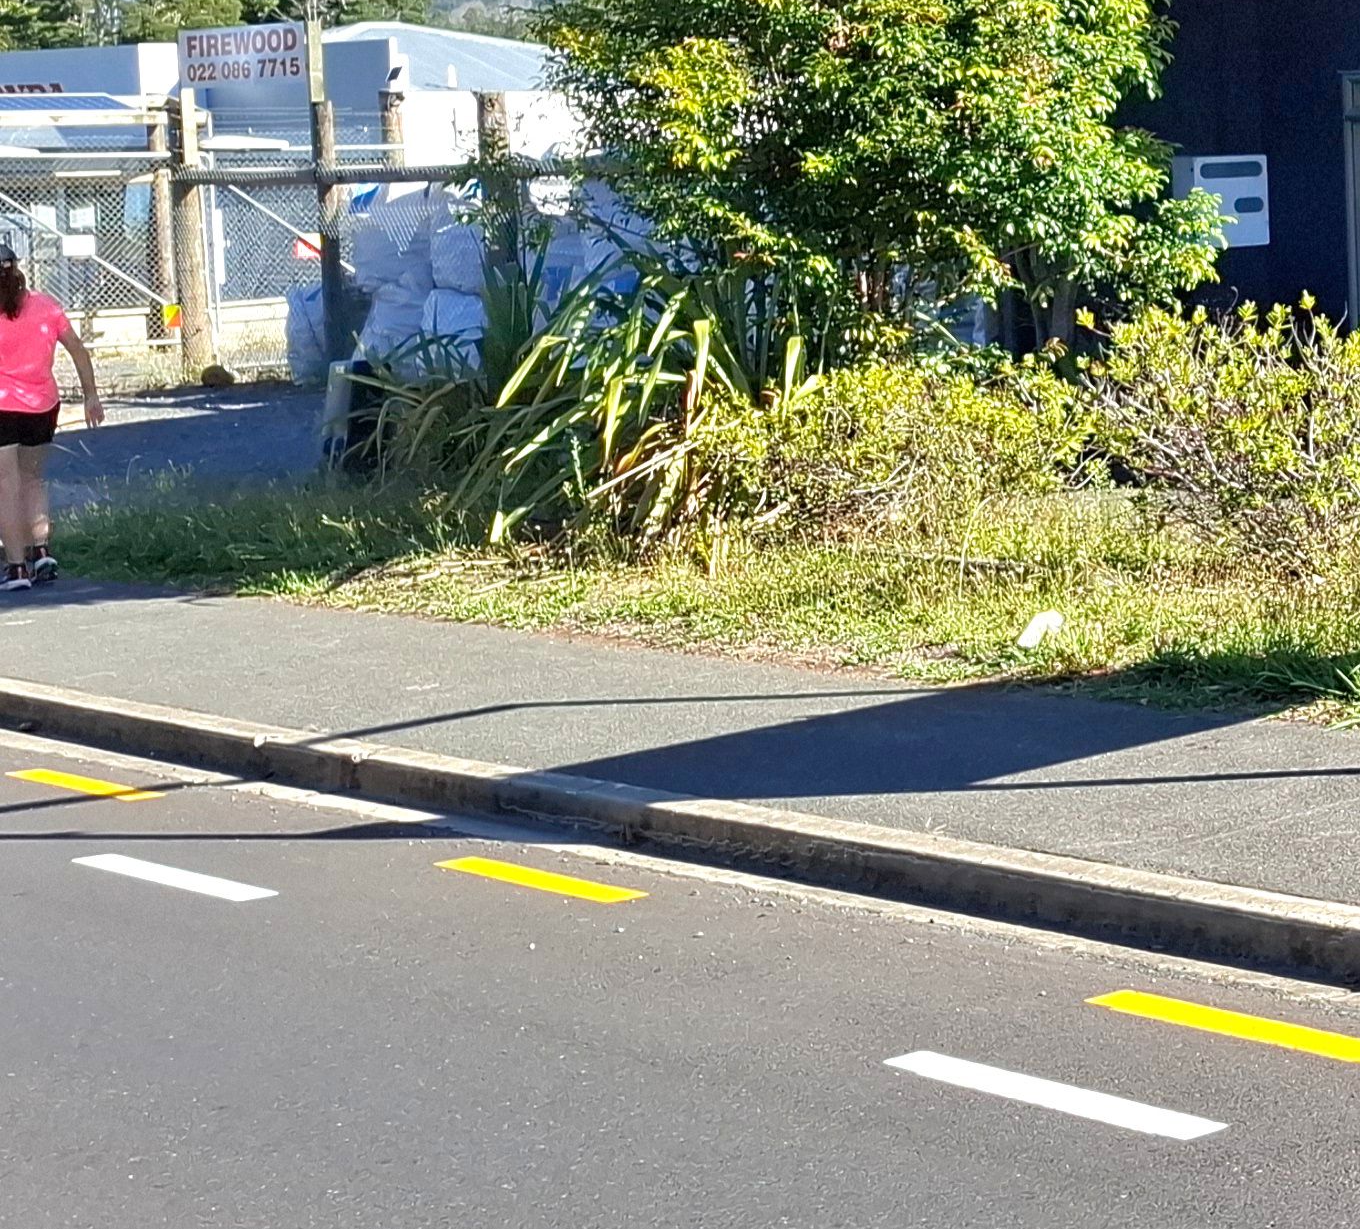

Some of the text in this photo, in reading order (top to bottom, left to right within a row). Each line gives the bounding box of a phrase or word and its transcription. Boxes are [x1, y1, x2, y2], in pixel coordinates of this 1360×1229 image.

[186, 28, 297, 58] FIREWOOD
[187, 57, 300, 82] 022 086 7715
